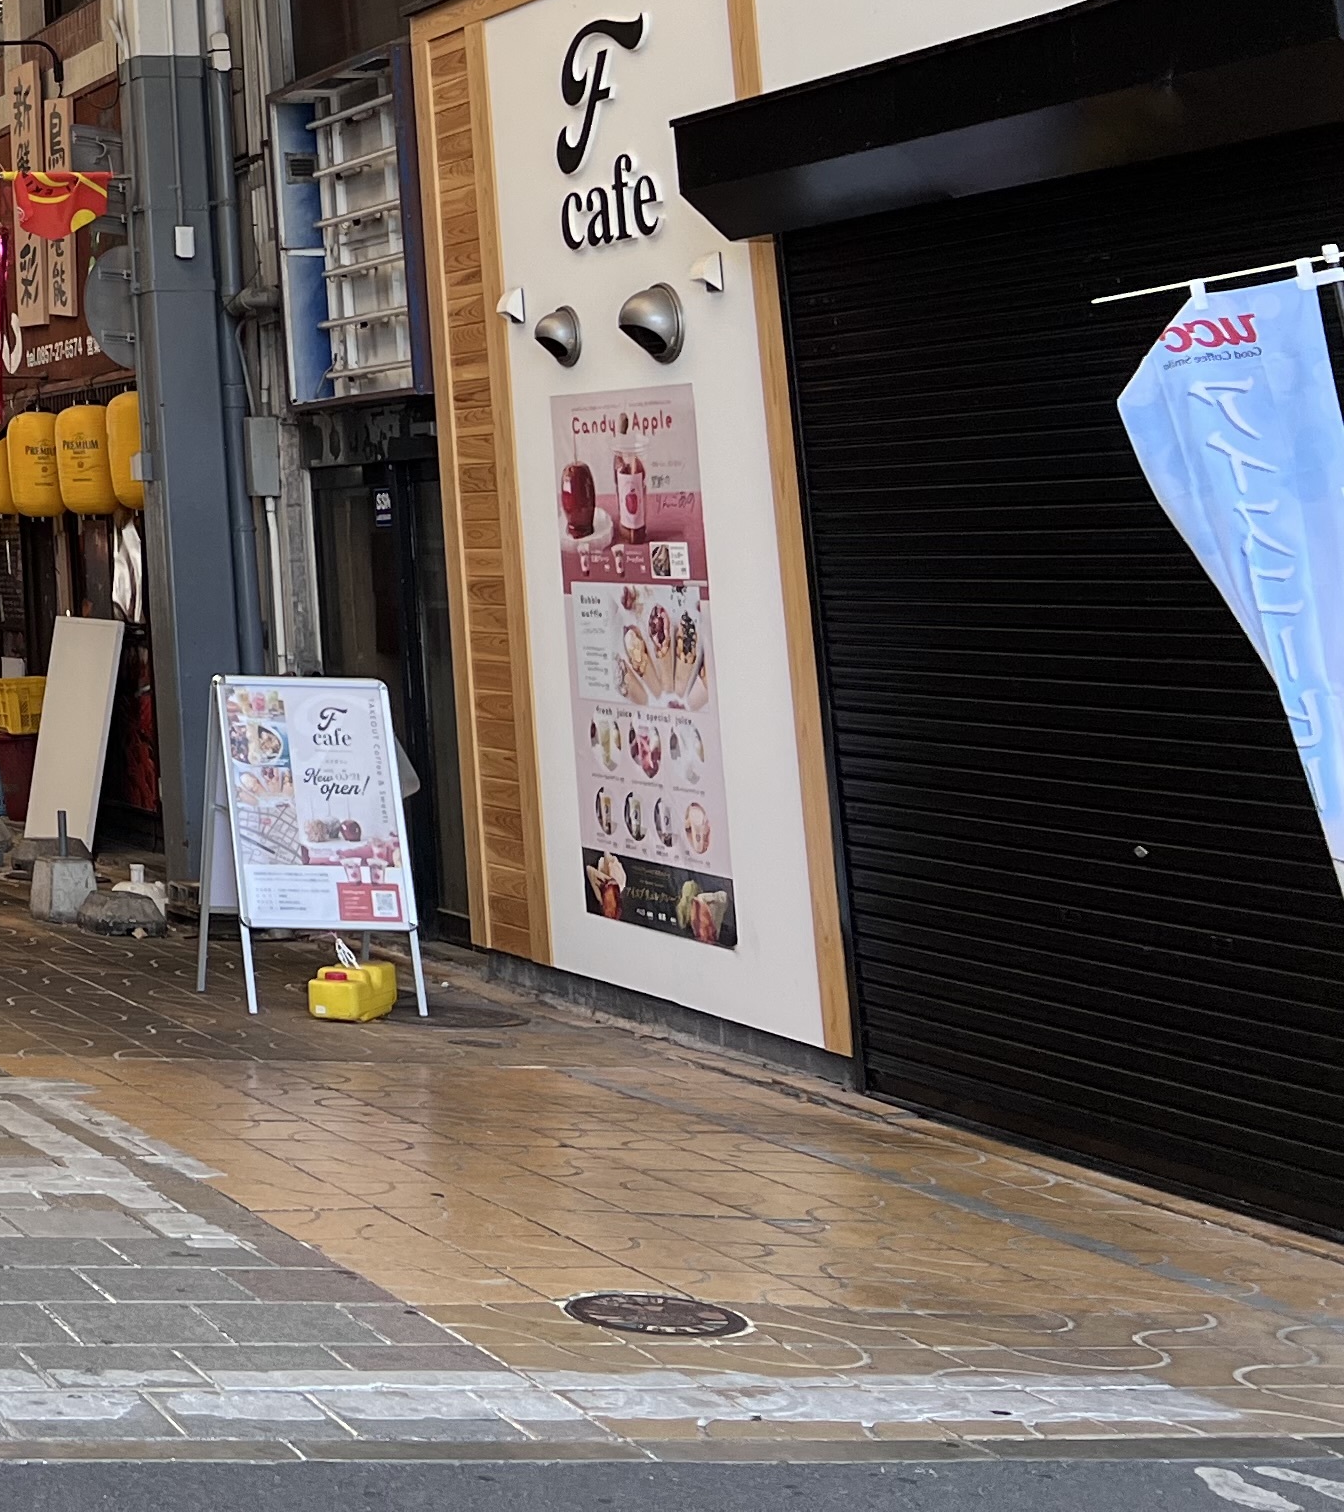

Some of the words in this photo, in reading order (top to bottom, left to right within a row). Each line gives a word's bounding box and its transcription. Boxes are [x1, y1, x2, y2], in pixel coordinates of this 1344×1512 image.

[556, 13, 643, 175] F
[561, 154, 659, 251] cafe
[572, 414, 616, 437] Candy
[632, 410, 672, 437] Apple
[62, 439, 100, 451] PREMIUM
[317, 706, 348, 732] F
[368, 698, 380, 741] TAKEOUT
[312, 729, 352, 748] cafe
[320, 776, 371, 802] open!
